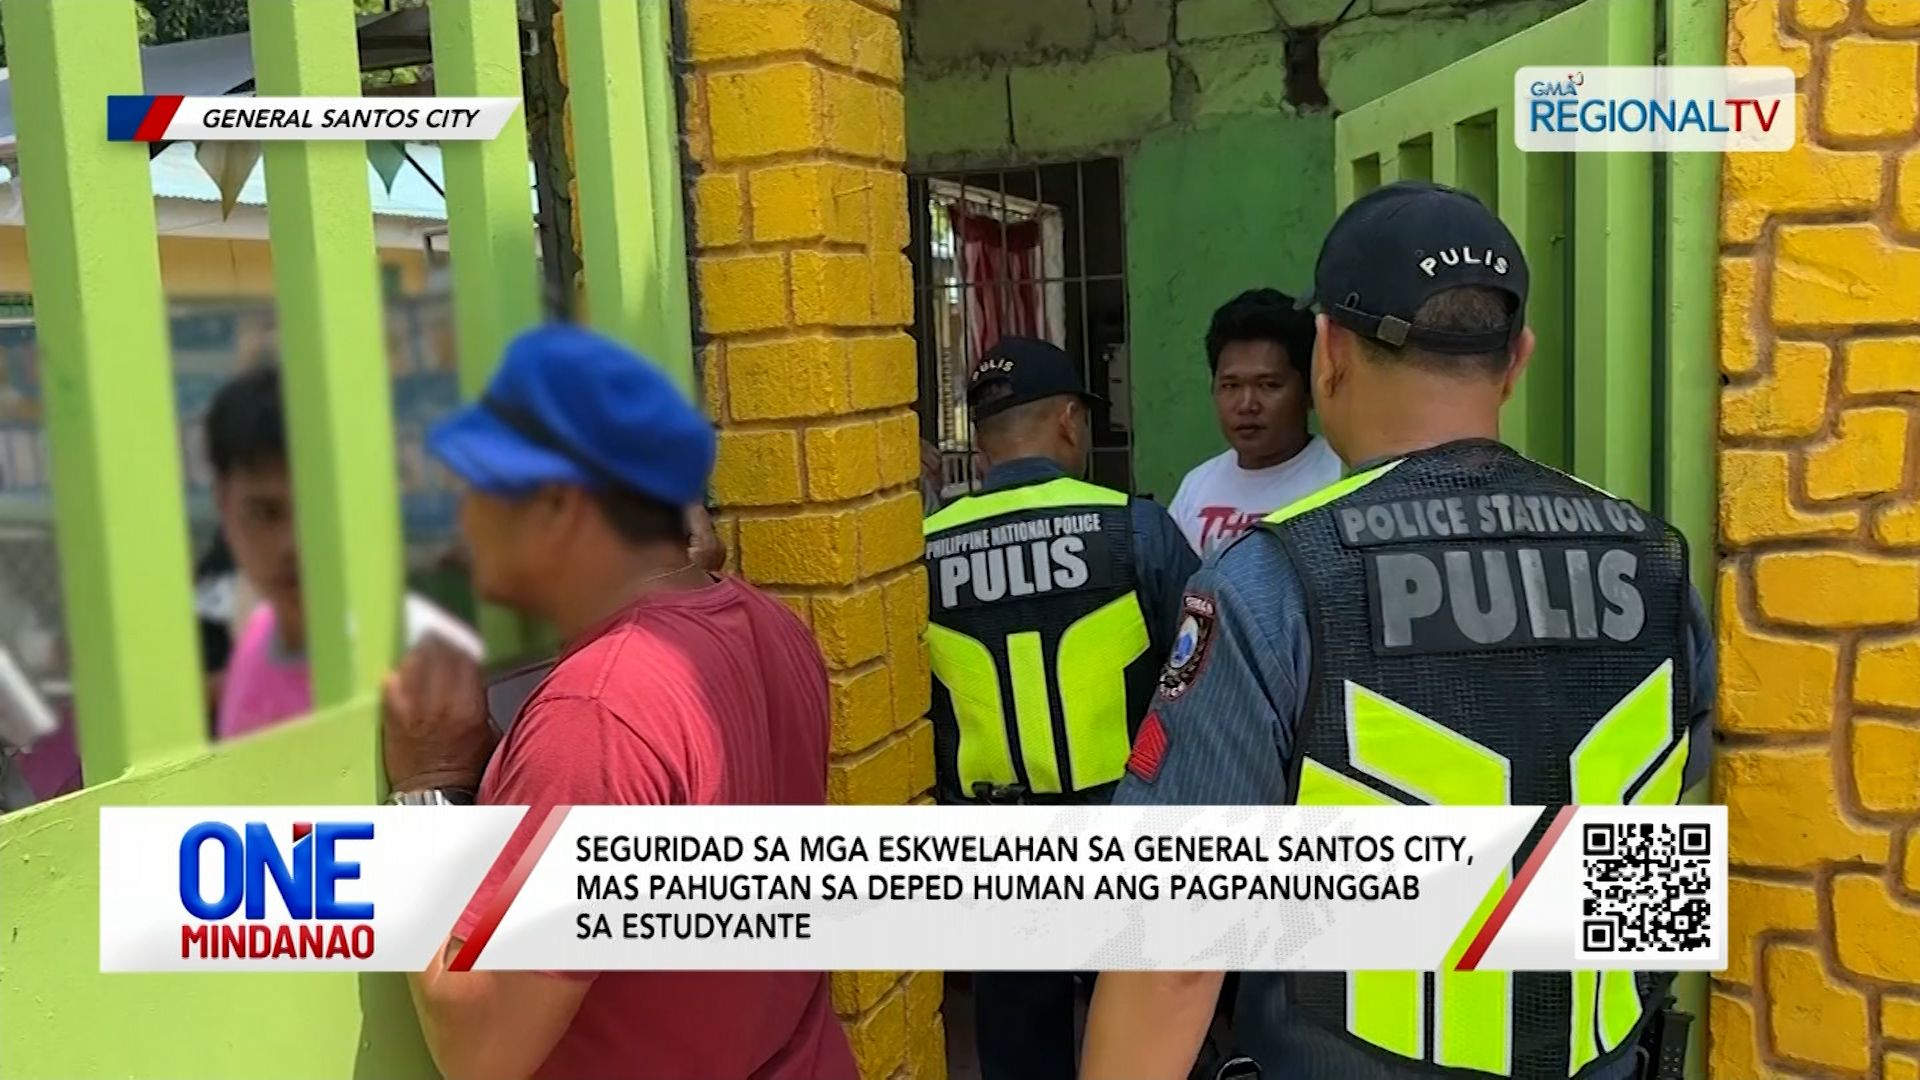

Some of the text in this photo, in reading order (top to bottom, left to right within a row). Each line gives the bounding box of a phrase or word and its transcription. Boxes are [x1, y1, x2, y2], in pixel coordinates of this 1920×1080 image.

[1419, 245, 1509, 277] PULIS
[926, 513, 1101, 559] PHILIPPINE NATIONAL POLICE
[1342, 494, 1646, 542] POLICE STATION 03
[940, 536, 1089, 608] PULIS
[1375, 548, 1646, 646] PULIS
